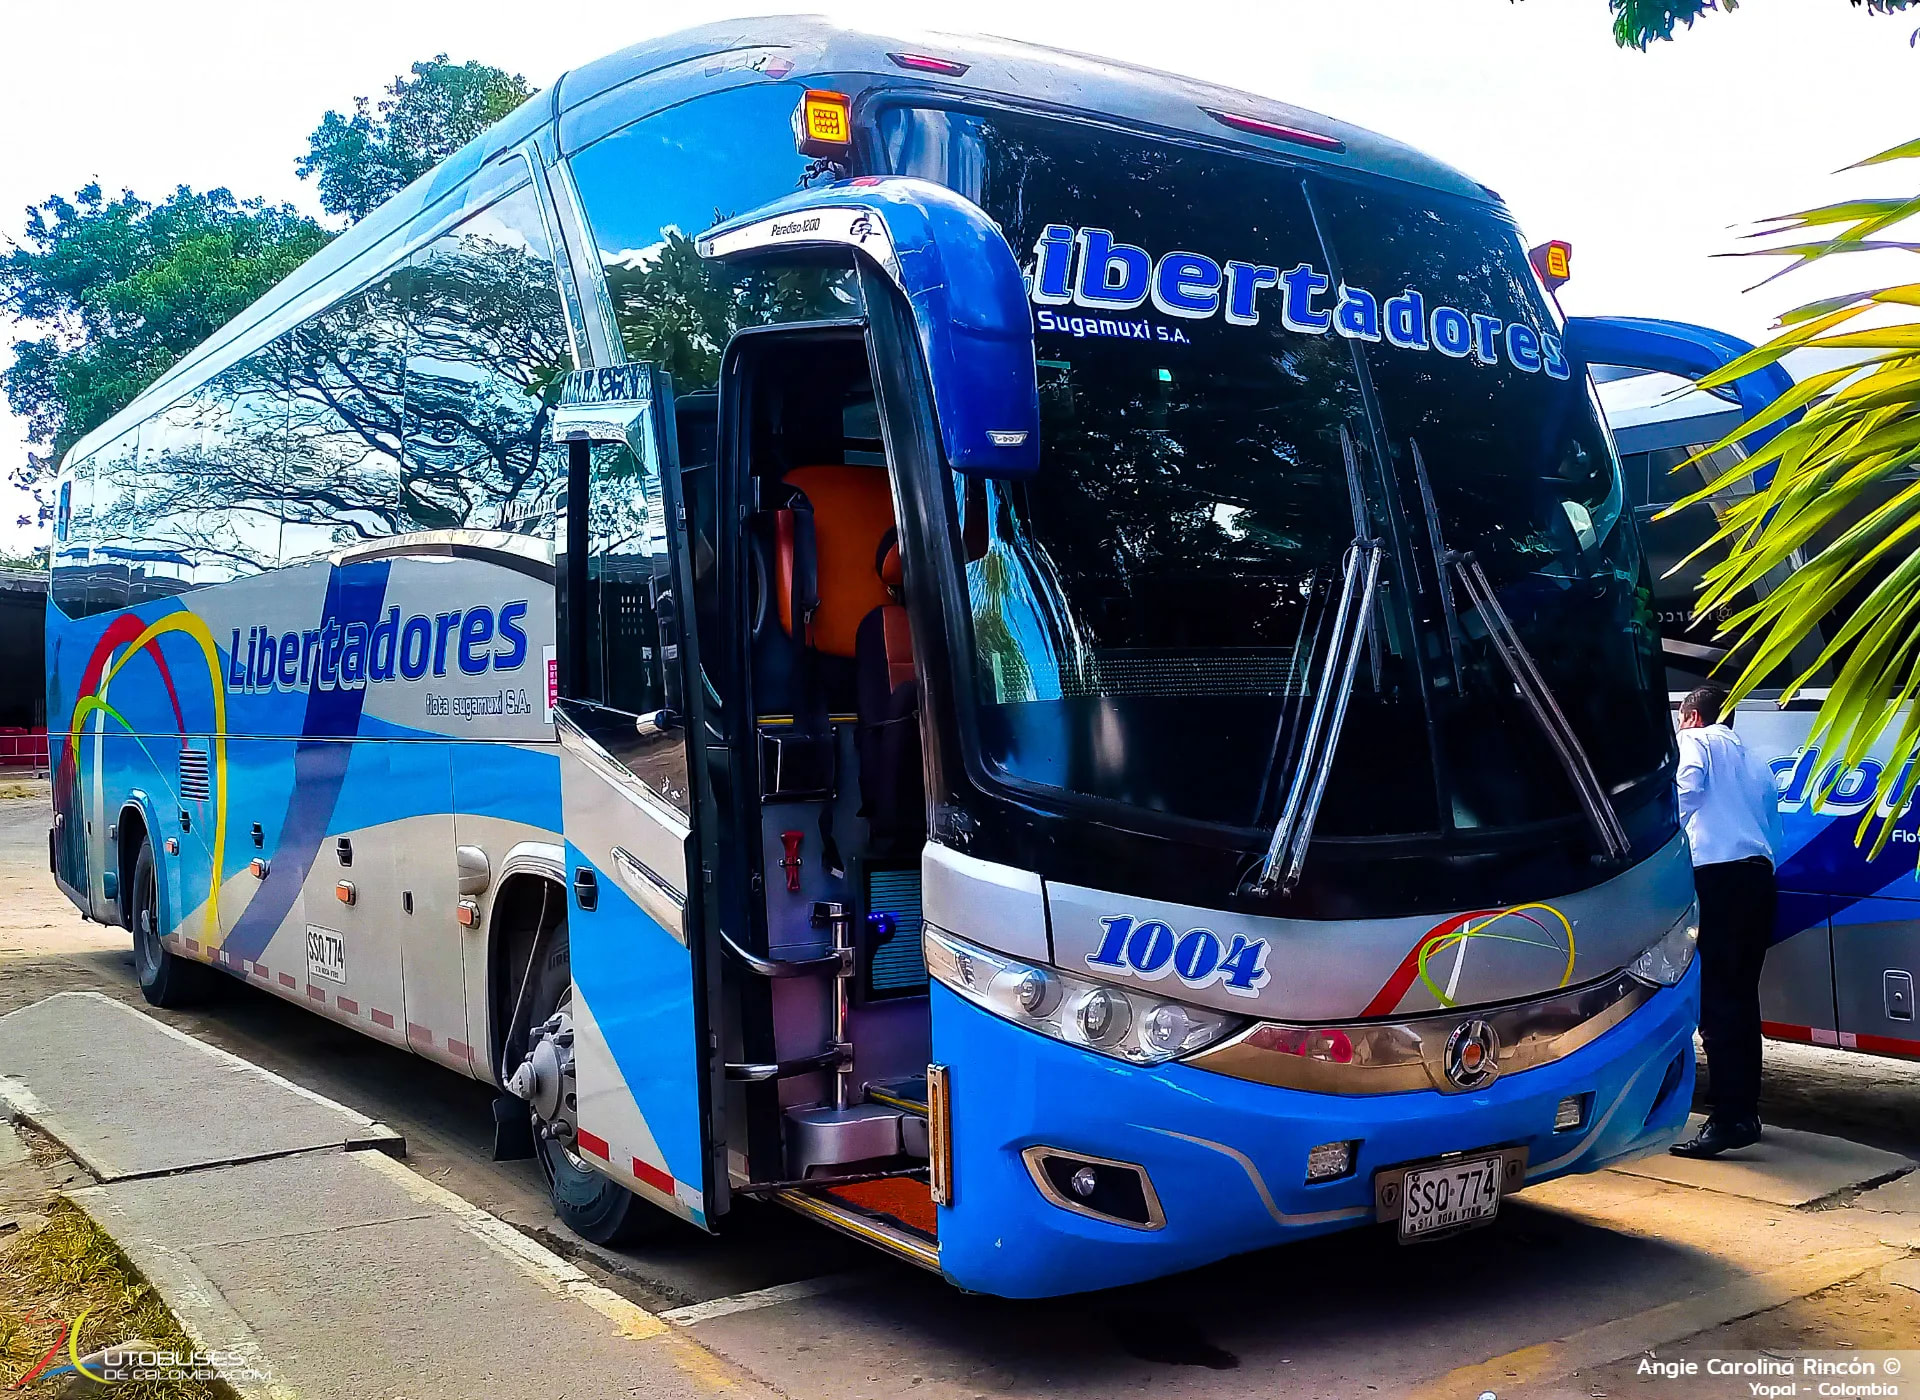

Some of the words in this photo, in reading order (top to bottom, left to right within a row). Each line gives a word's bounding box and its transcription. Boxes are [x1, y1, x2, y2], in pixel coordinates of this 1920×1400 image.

[1028, 223, 1571, 381] ibertadores
[1037, 310, 1151, 339] Sugamuxi
[1156, 326, 1191, 345] S.A.
[227, 599, 529, 694] Libertadores
[506, 688, 531, 714] S.A.
[1084, 913, 1272, 999] 1004
